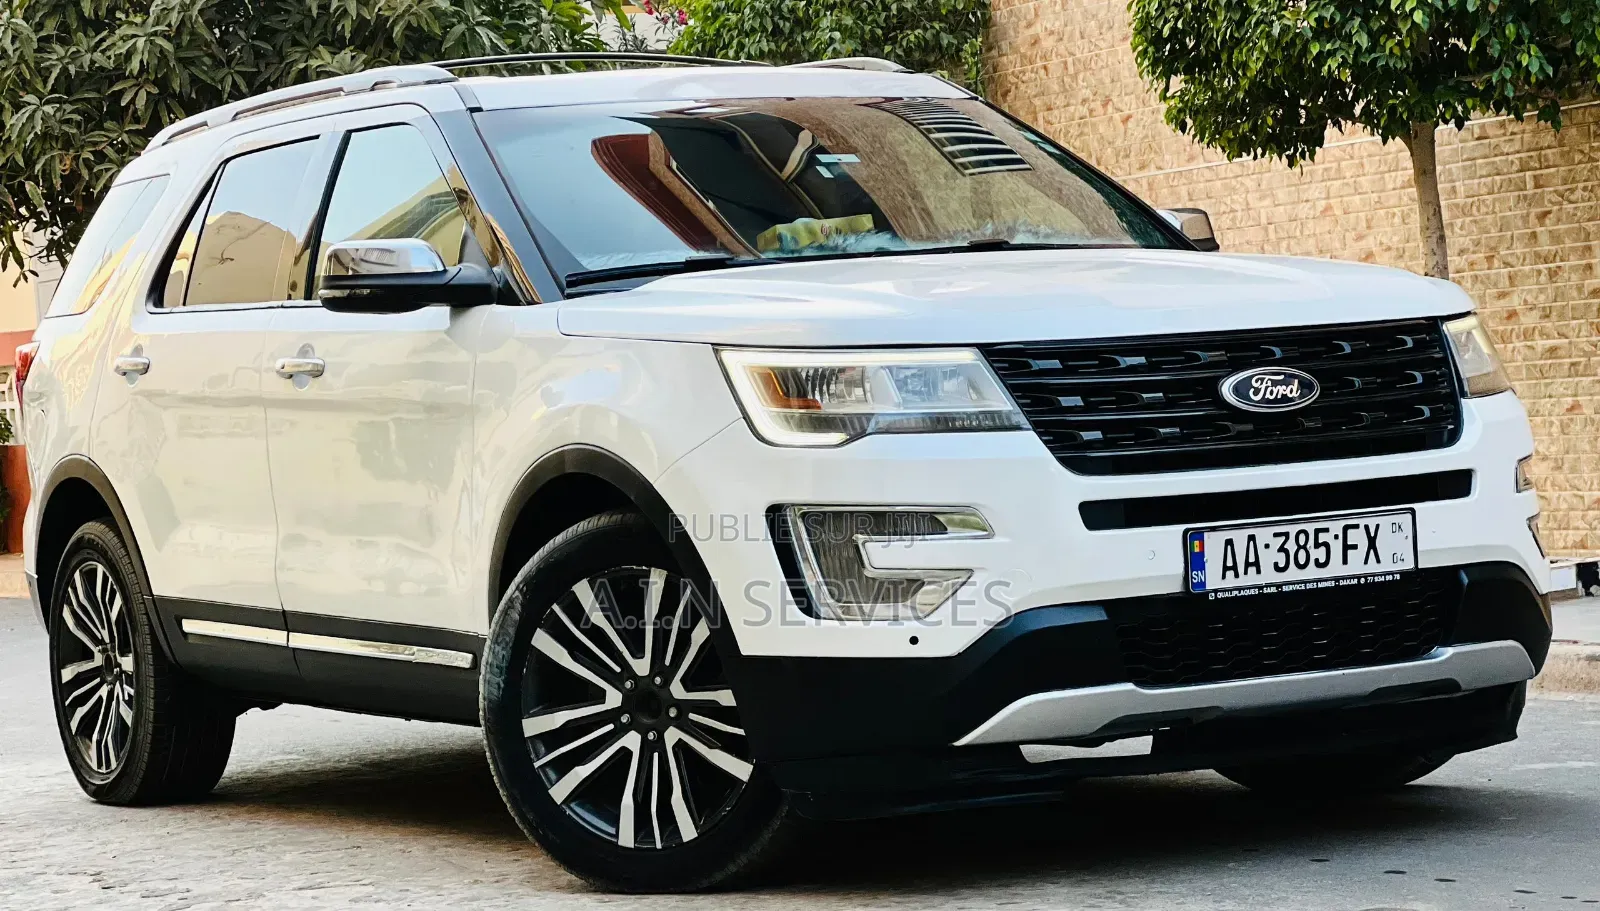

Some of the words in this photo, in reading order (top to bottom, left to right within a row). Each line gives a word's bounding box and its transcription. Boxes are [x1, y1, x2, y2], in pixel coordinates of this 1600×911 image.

[1249, 375, 1300, 401] Ford
[1391, 522, 1404, 533] DK
[1192, 571, 1205, 583] SN
[1216, 588, 1259, 599] QUALIPLAQUES
[1263, 586, 1278, 594] SARL
[1282, 583, 1305, 592] SERVICE
[1306, 582, 1317, 590] DES
[1339, 578, 1358, 586] DAKAR
